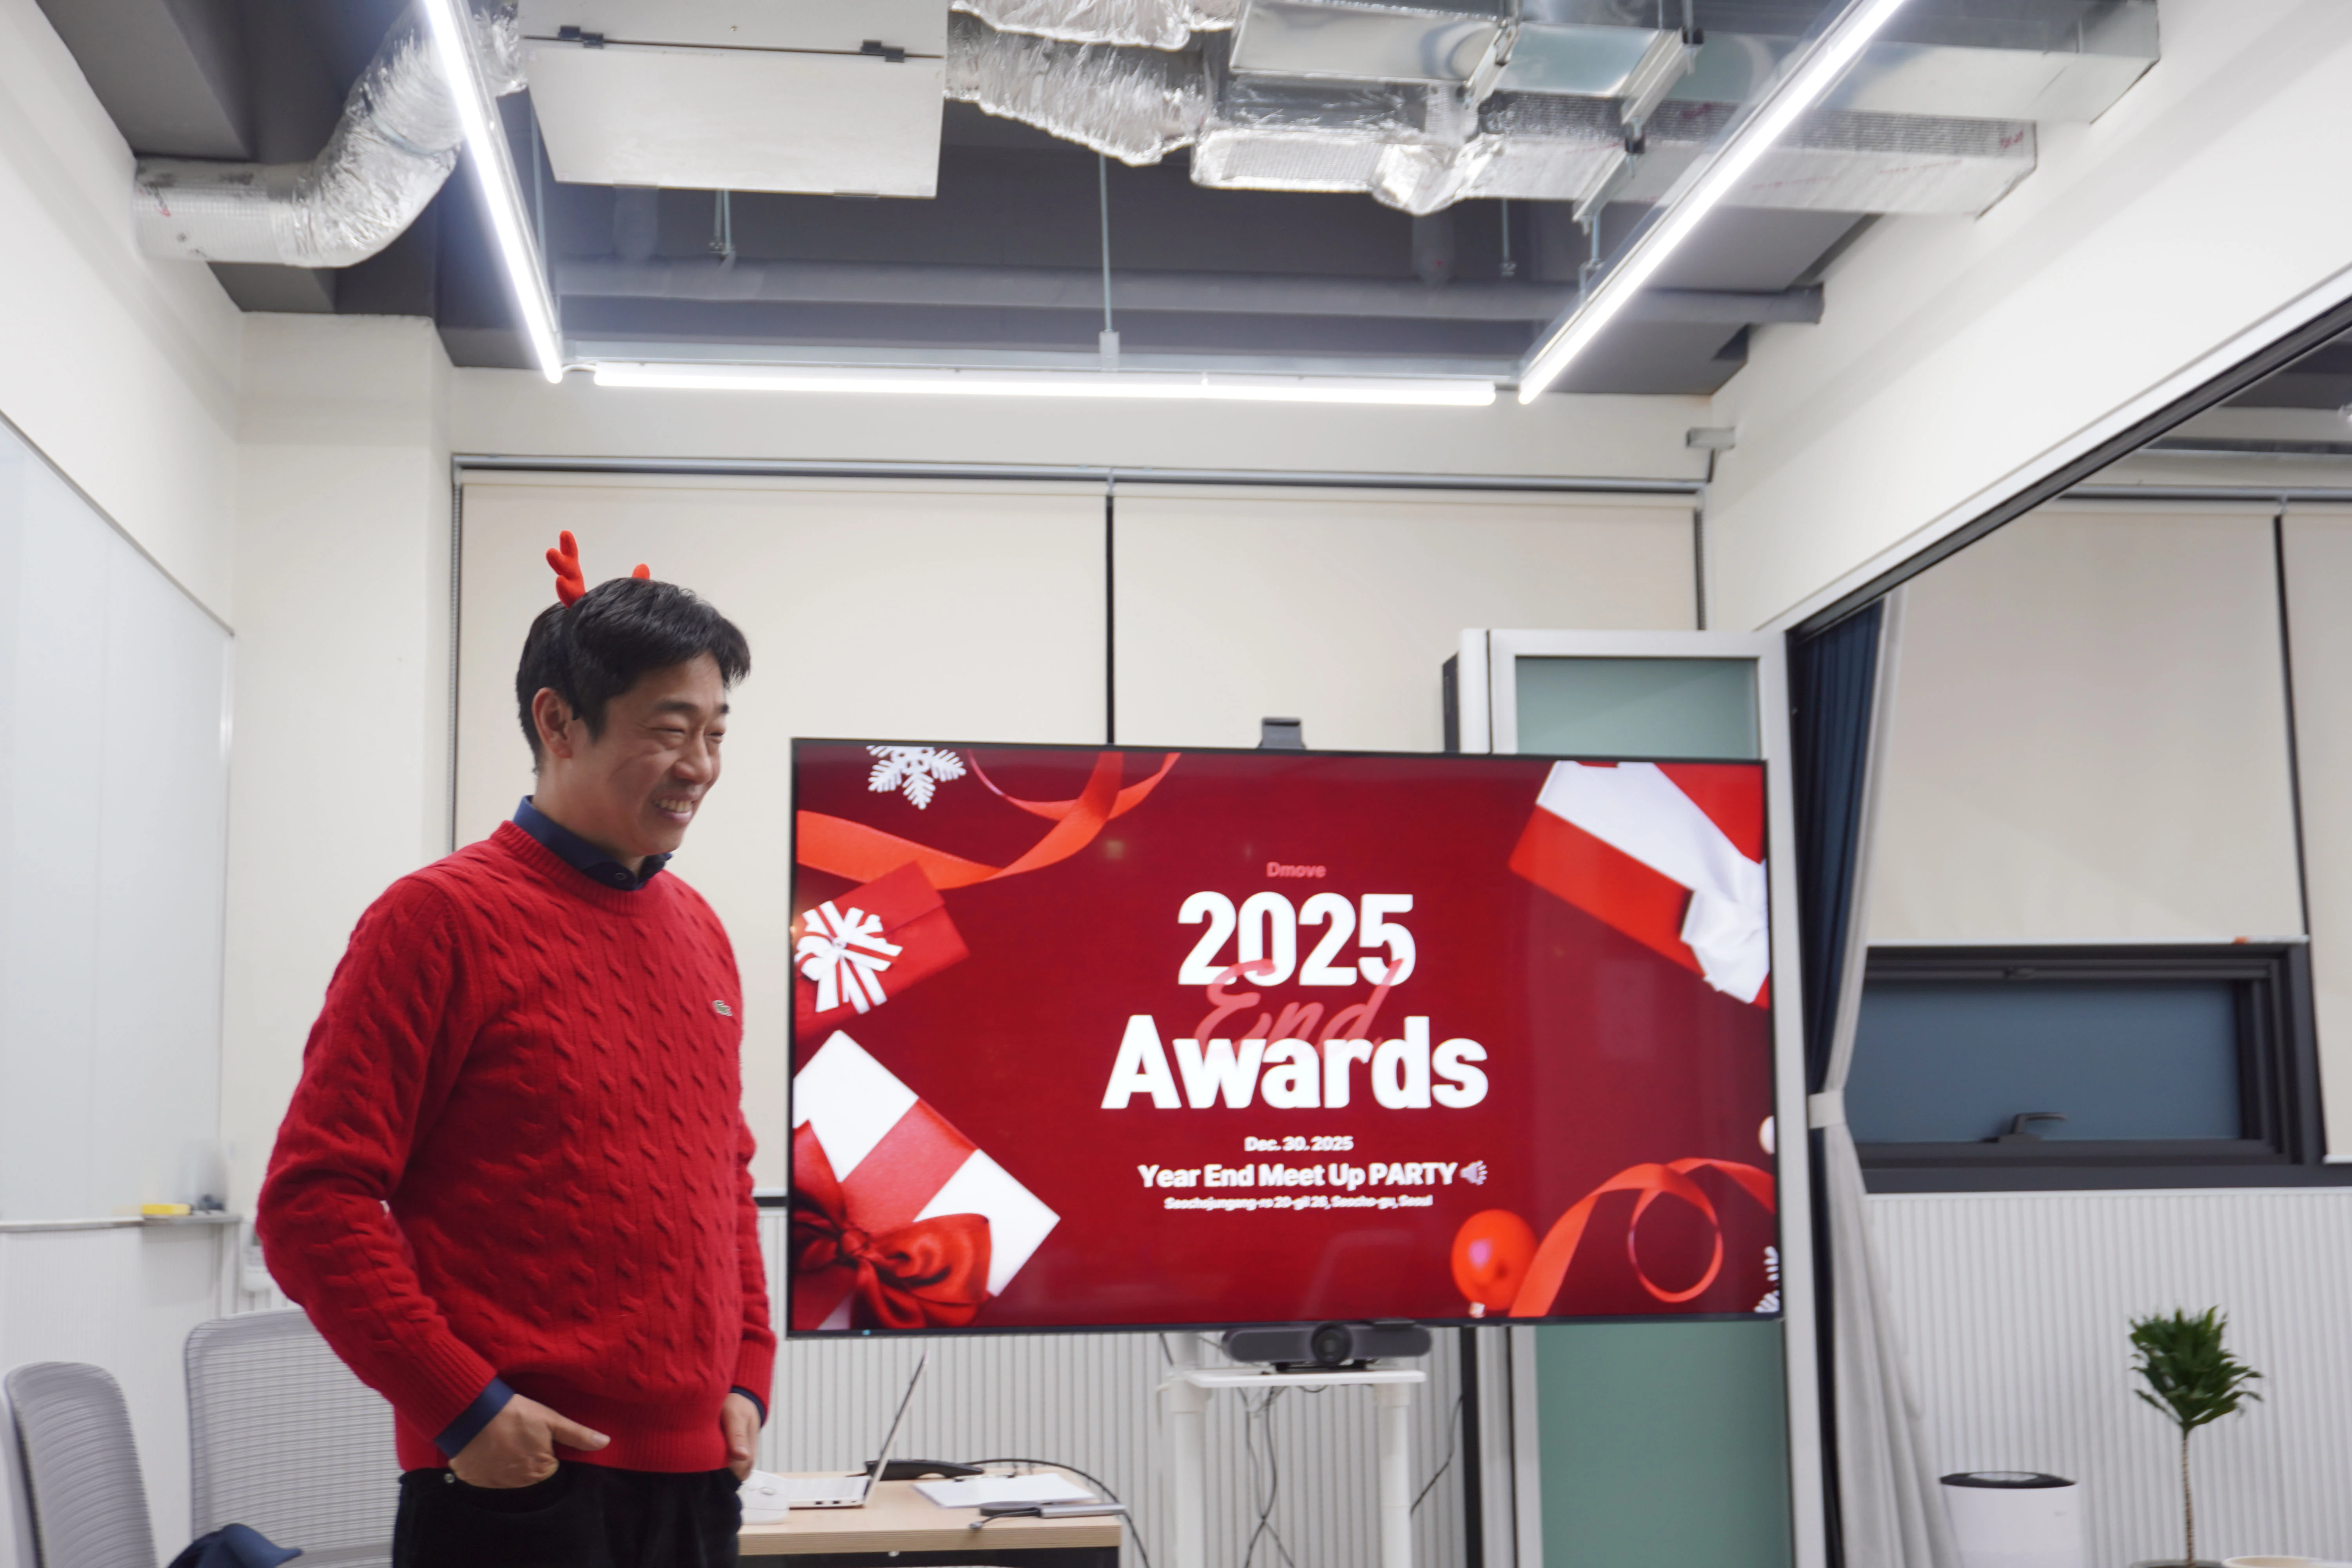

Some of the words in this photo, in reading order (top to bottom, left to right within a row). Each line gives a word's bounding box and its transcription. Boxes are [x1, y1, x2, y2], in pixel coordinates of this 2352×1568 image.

[1267, 862, 1327, 878] Dmove
[1178, 891, 1416, 986] 2025
[1192, 958, 1384, 1057] End
[1100, 1014, 1489, 1109] Awards
[1244, 1136, 1281, 1152] Dec.
[1282, 1135, 1310, 1151] 30.
[1310, 1135, 1354, 1151] 2025
[1137, 1164, 1201, 1188] Year
[1204, 1163, 1255, 1188] End
[1258, 1163, 1326, 1187] Meet
[1328, 1162, 1366, 1192] Up
[1368, 1161, 1458, 1186] PARTY
